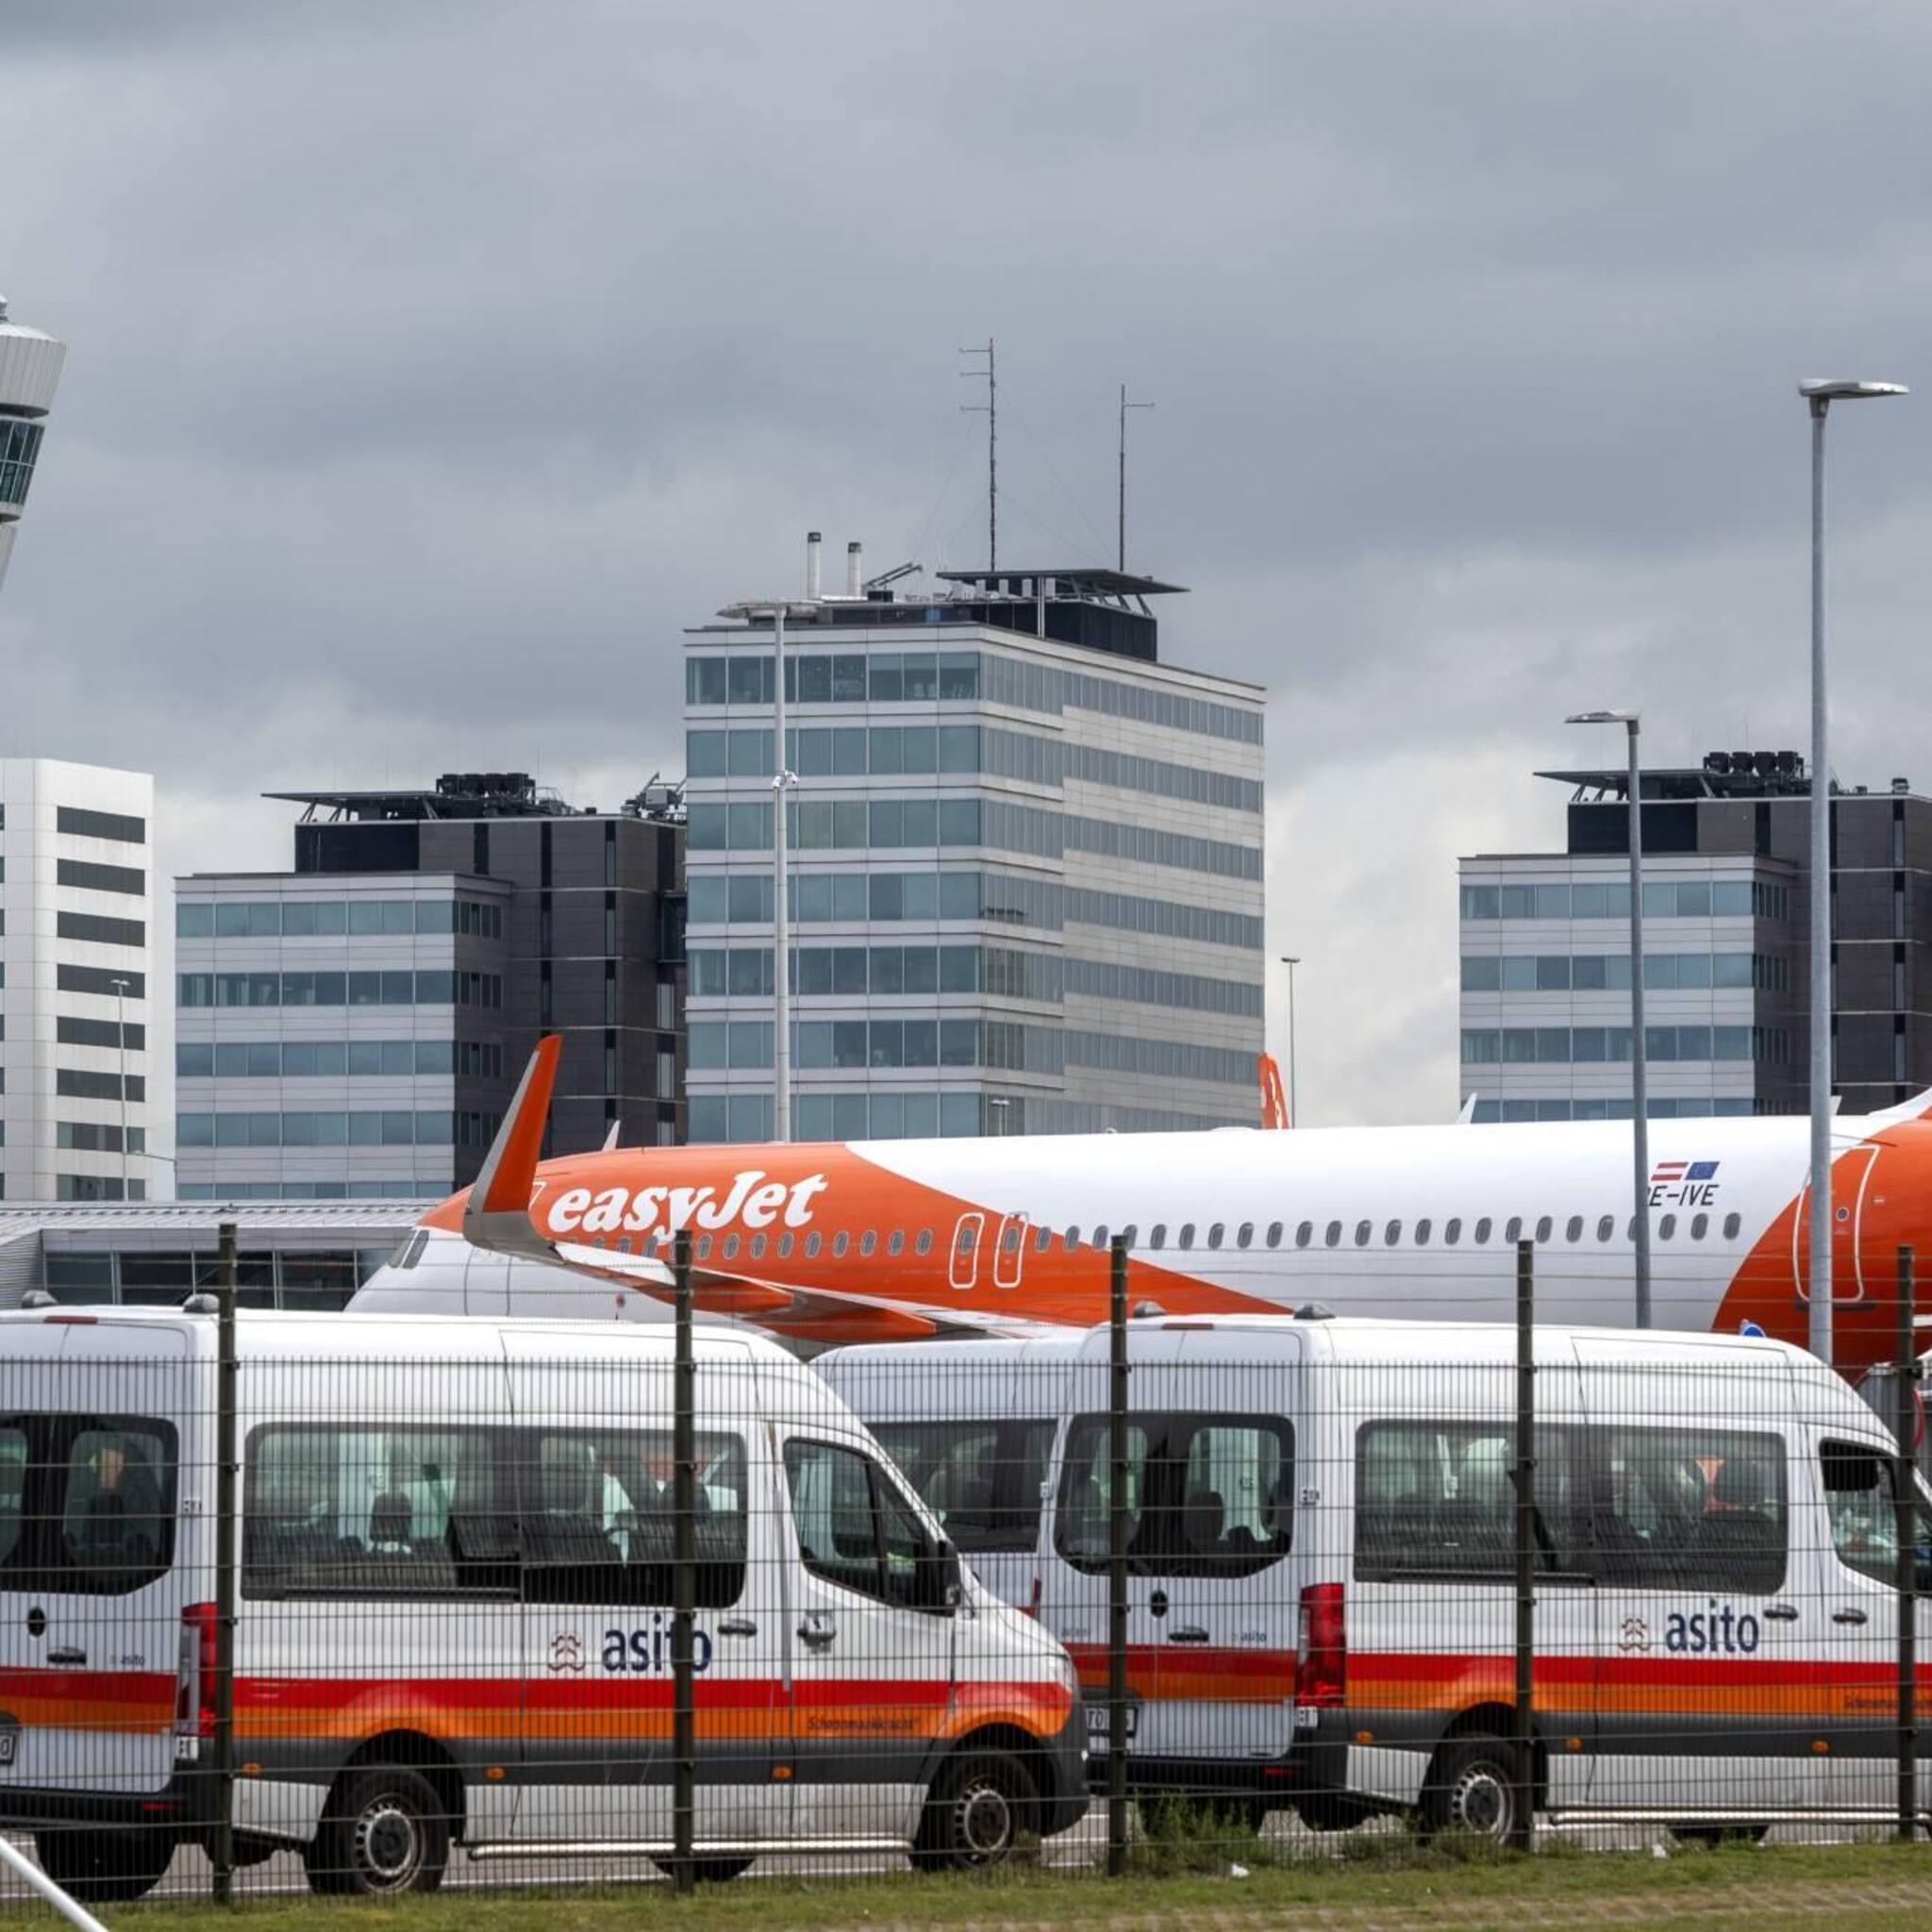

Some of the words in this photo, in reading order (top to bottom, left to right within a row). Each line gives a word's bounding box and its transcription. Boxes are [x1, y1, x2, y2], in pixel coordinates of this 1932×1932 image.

[547, 1171, 828, 1245] easyJet
[1647, 1184, 1720, 1207] E-IVE
[1665, 1598, 1759, 1654] asito
